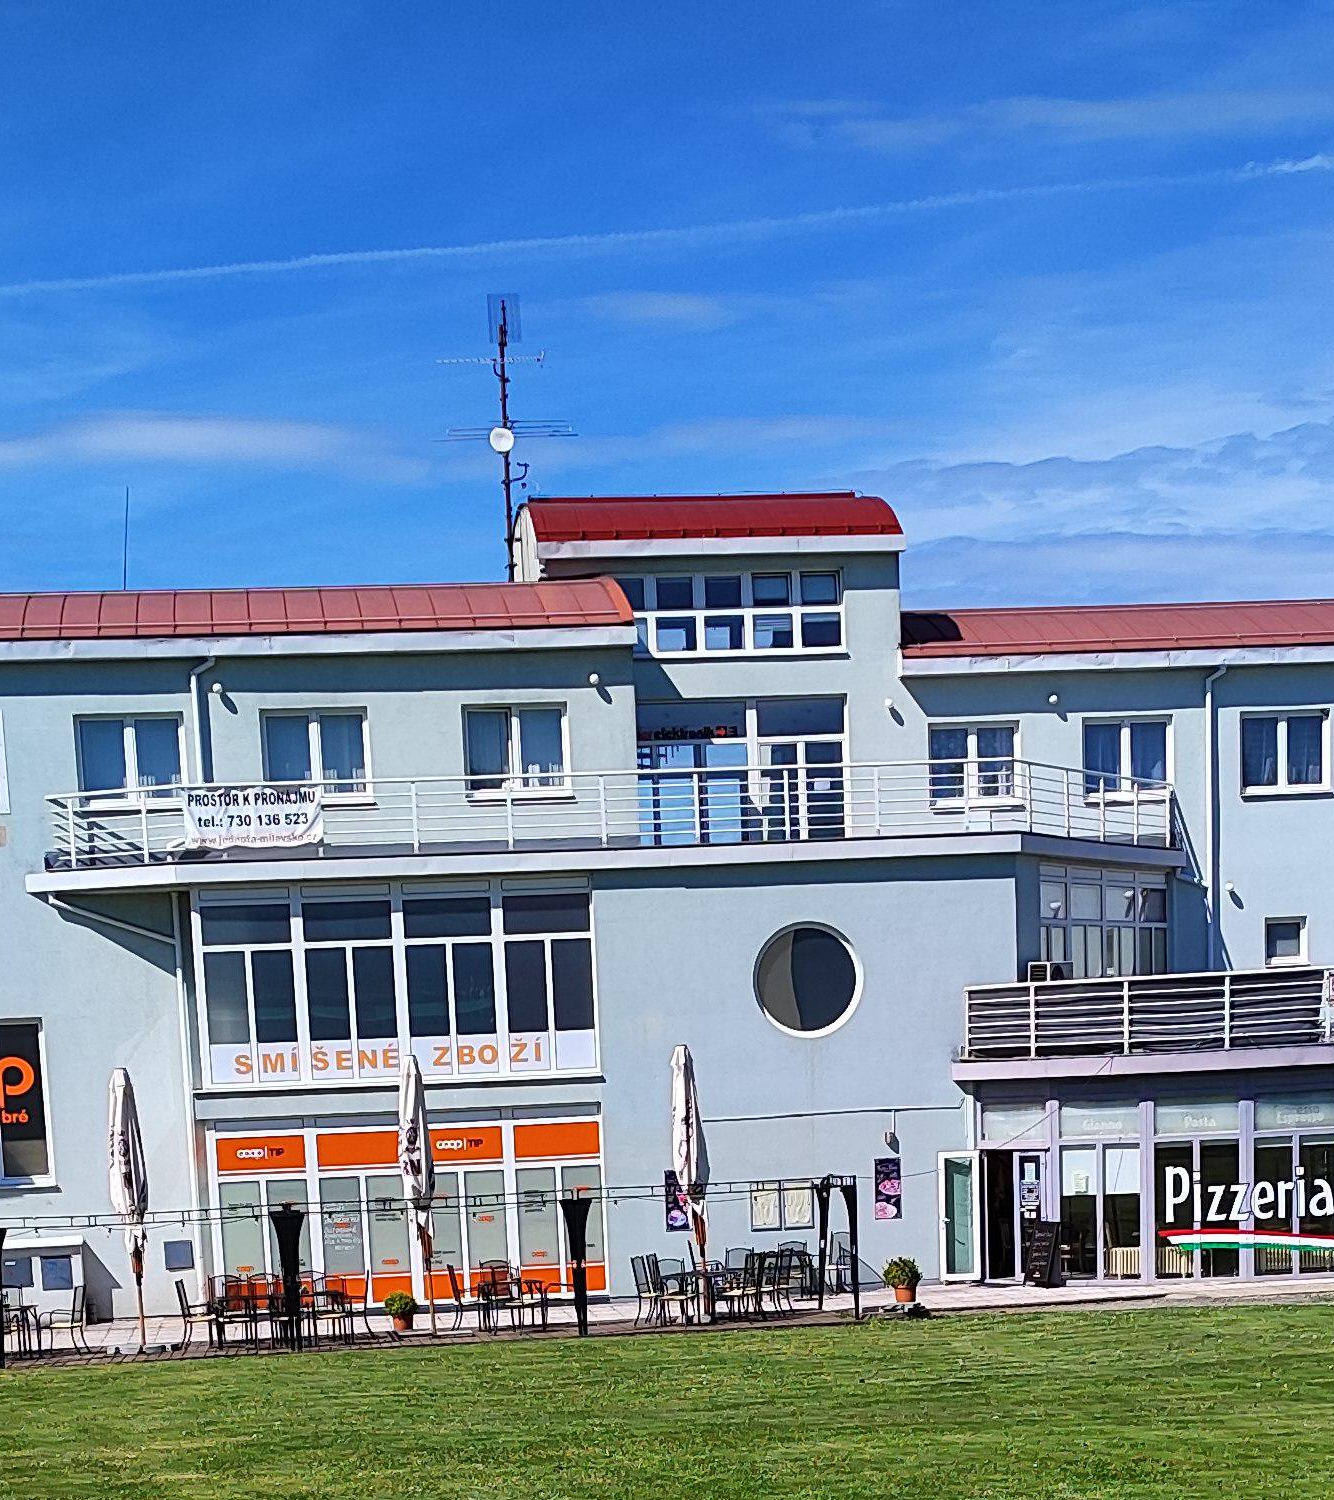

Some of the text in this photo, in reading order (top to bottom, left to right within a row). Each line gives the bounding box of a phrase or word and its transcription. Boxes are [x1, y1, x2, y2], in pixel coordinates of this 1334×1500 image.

[187, 790, 316, 808] PROSTOR K PRONÁJMU
[197, 812, 309, 828] tel.: 730 136 523
[234, 1036, 542, 1075] SMÍŠENÉ ZBOŽÍ
[269, 1147, 285, 1157] TIP
[436, 1138, 484, 1150] coop TIP
[1165, 1165, 1334, 1224] Pizzeria
